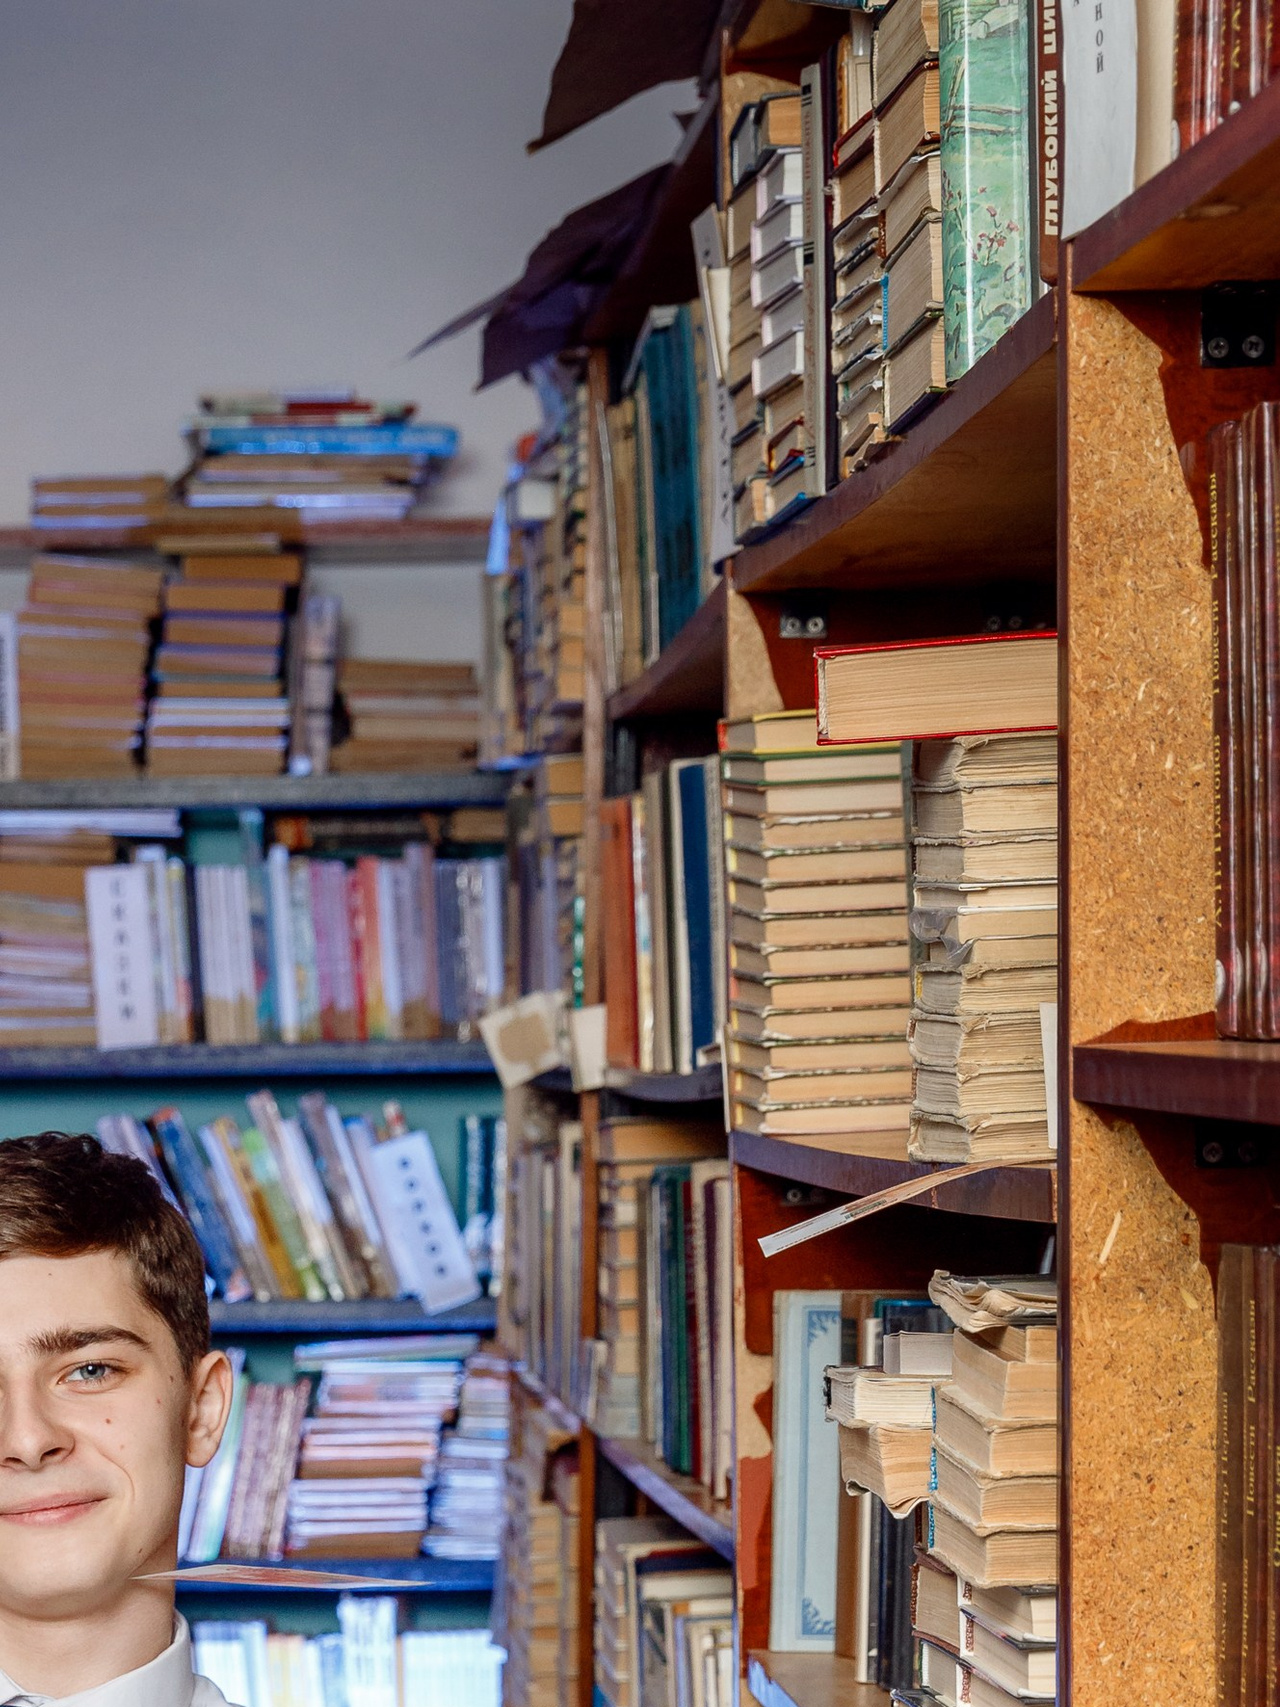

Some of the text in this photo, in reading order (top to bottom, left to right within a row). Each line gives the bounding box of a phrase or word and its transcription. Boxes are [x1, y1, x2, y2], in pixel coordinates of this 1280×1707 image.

[1040, 69, 1059, 237] ГЛУБОКИЙ
[1209, 472, 1218, 581] Рассказы
[1211, 599, 1220, 696] Повести
[1213, 734, 1222, 854] Платонов
[1246, 1299, 1256, 1404] Рассказы
[1246, 1424, 1256, 1517] Повести
